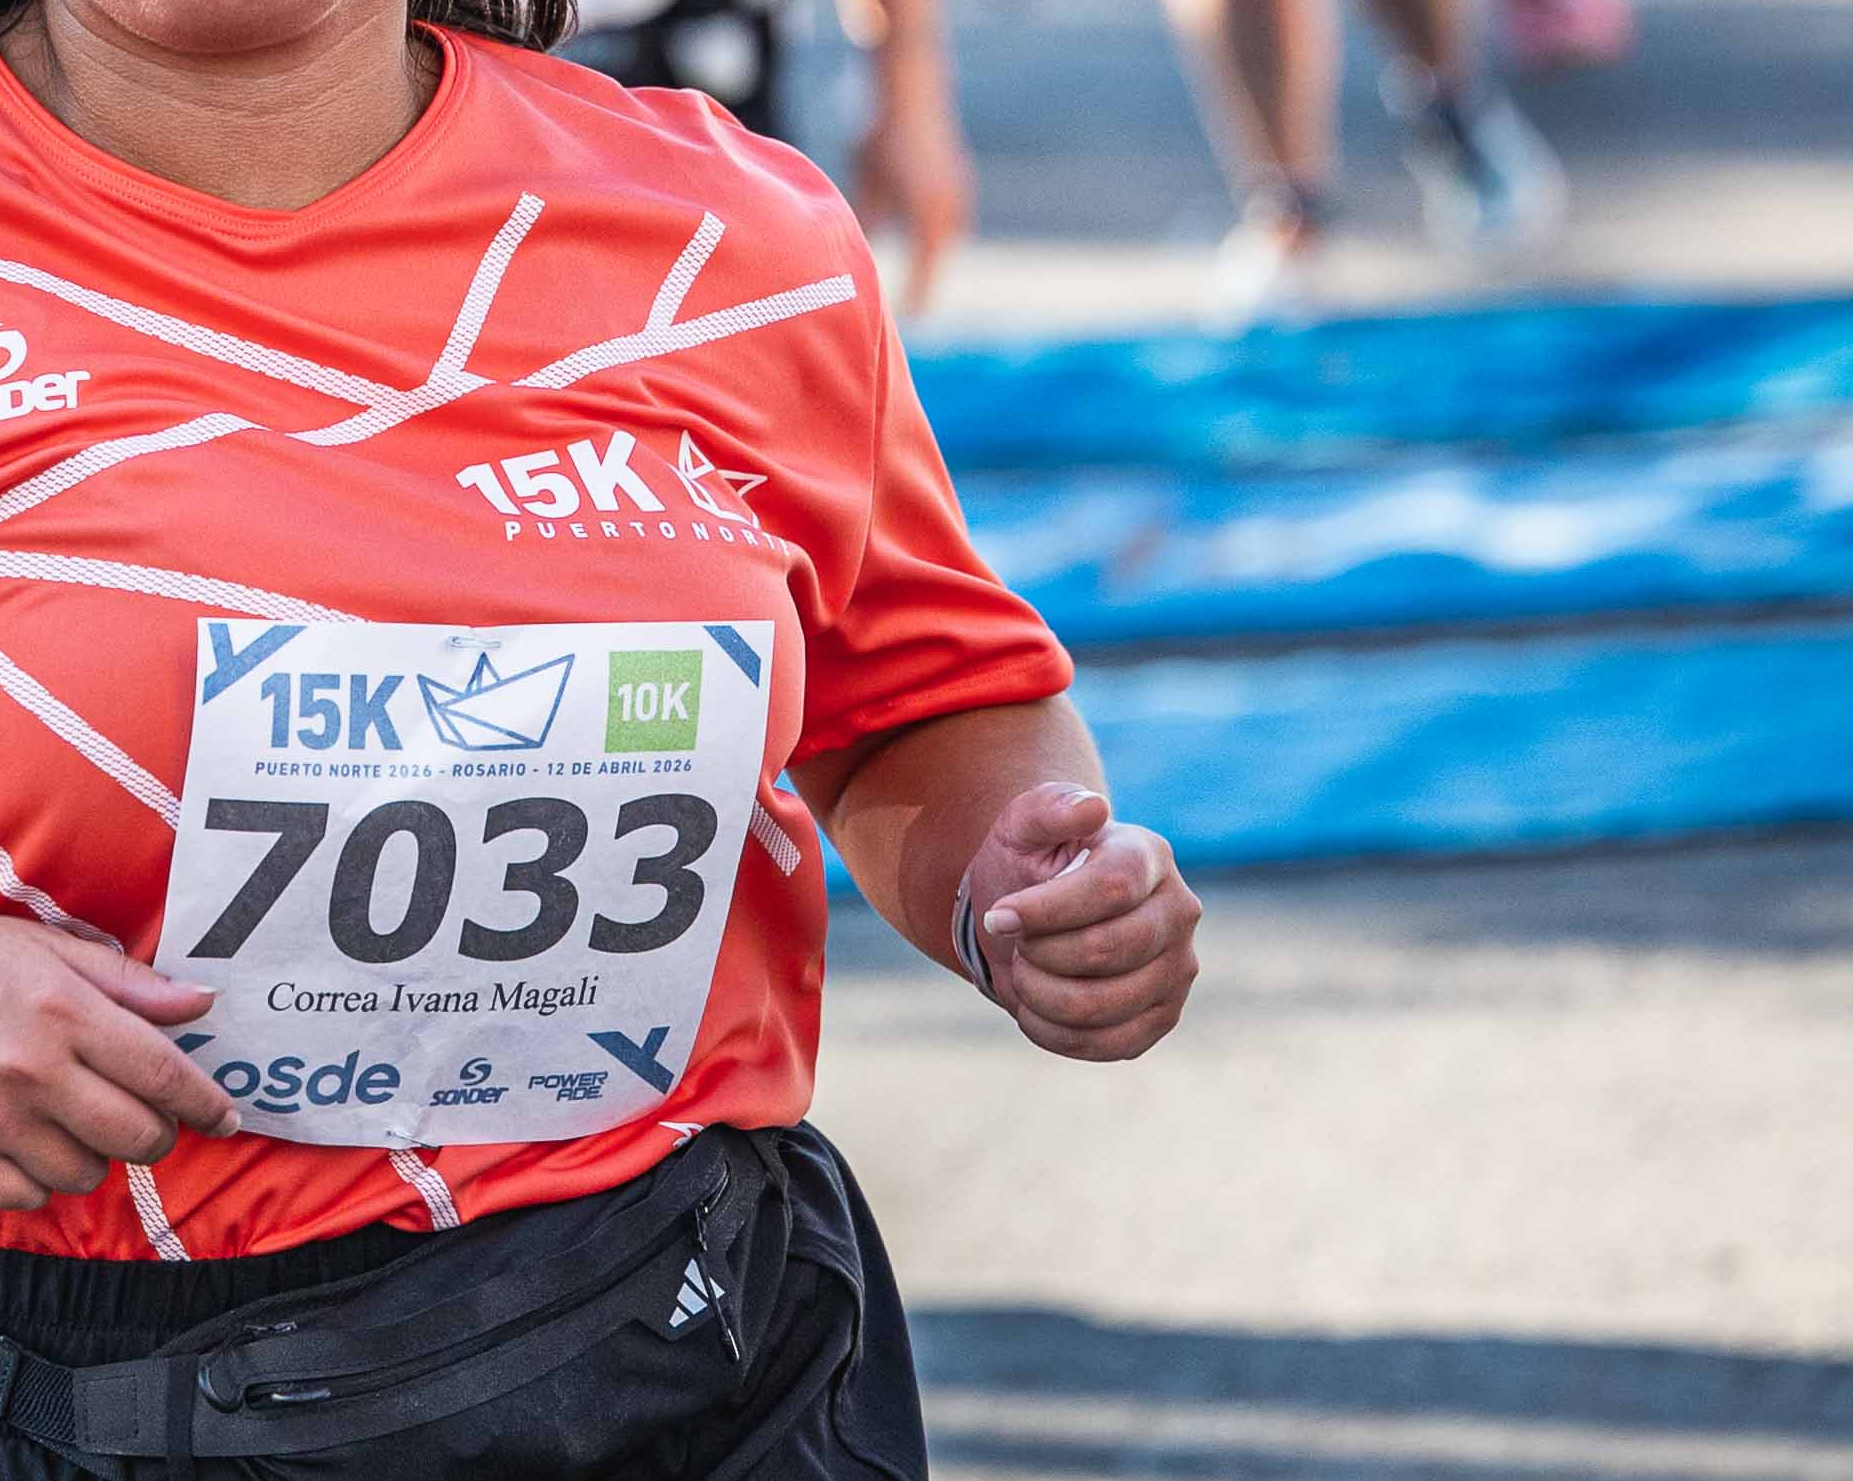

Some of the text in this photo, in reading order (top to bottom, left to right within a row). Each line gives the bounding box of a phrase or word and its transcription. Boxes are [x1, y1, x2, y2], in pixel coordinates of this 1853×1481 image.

[455, 430, 666, 518] 15K
[505, 521, 676, 541] PUERTO
[260, 672, 405, 751] 15K
[616, 681, 691, 722] 10K
[255, 762, 322, 777] PUERTO
[329, 764, 381, 778] NORTE
[389, 764, 432, 778] 2026
[452, 762, 526, 777] ROSARIO
[547, 763, 565, 777] 12
[571, 762, 593, 775] DE
[597, 760, 646, 775] ABRIL
[652, 759, 692, 773] 2026
[185, 793, 718, 964] 7033
[267, 975, 600, 1016] Correa Ivana Magali
[528, 1071, 609, 1089] POWER
